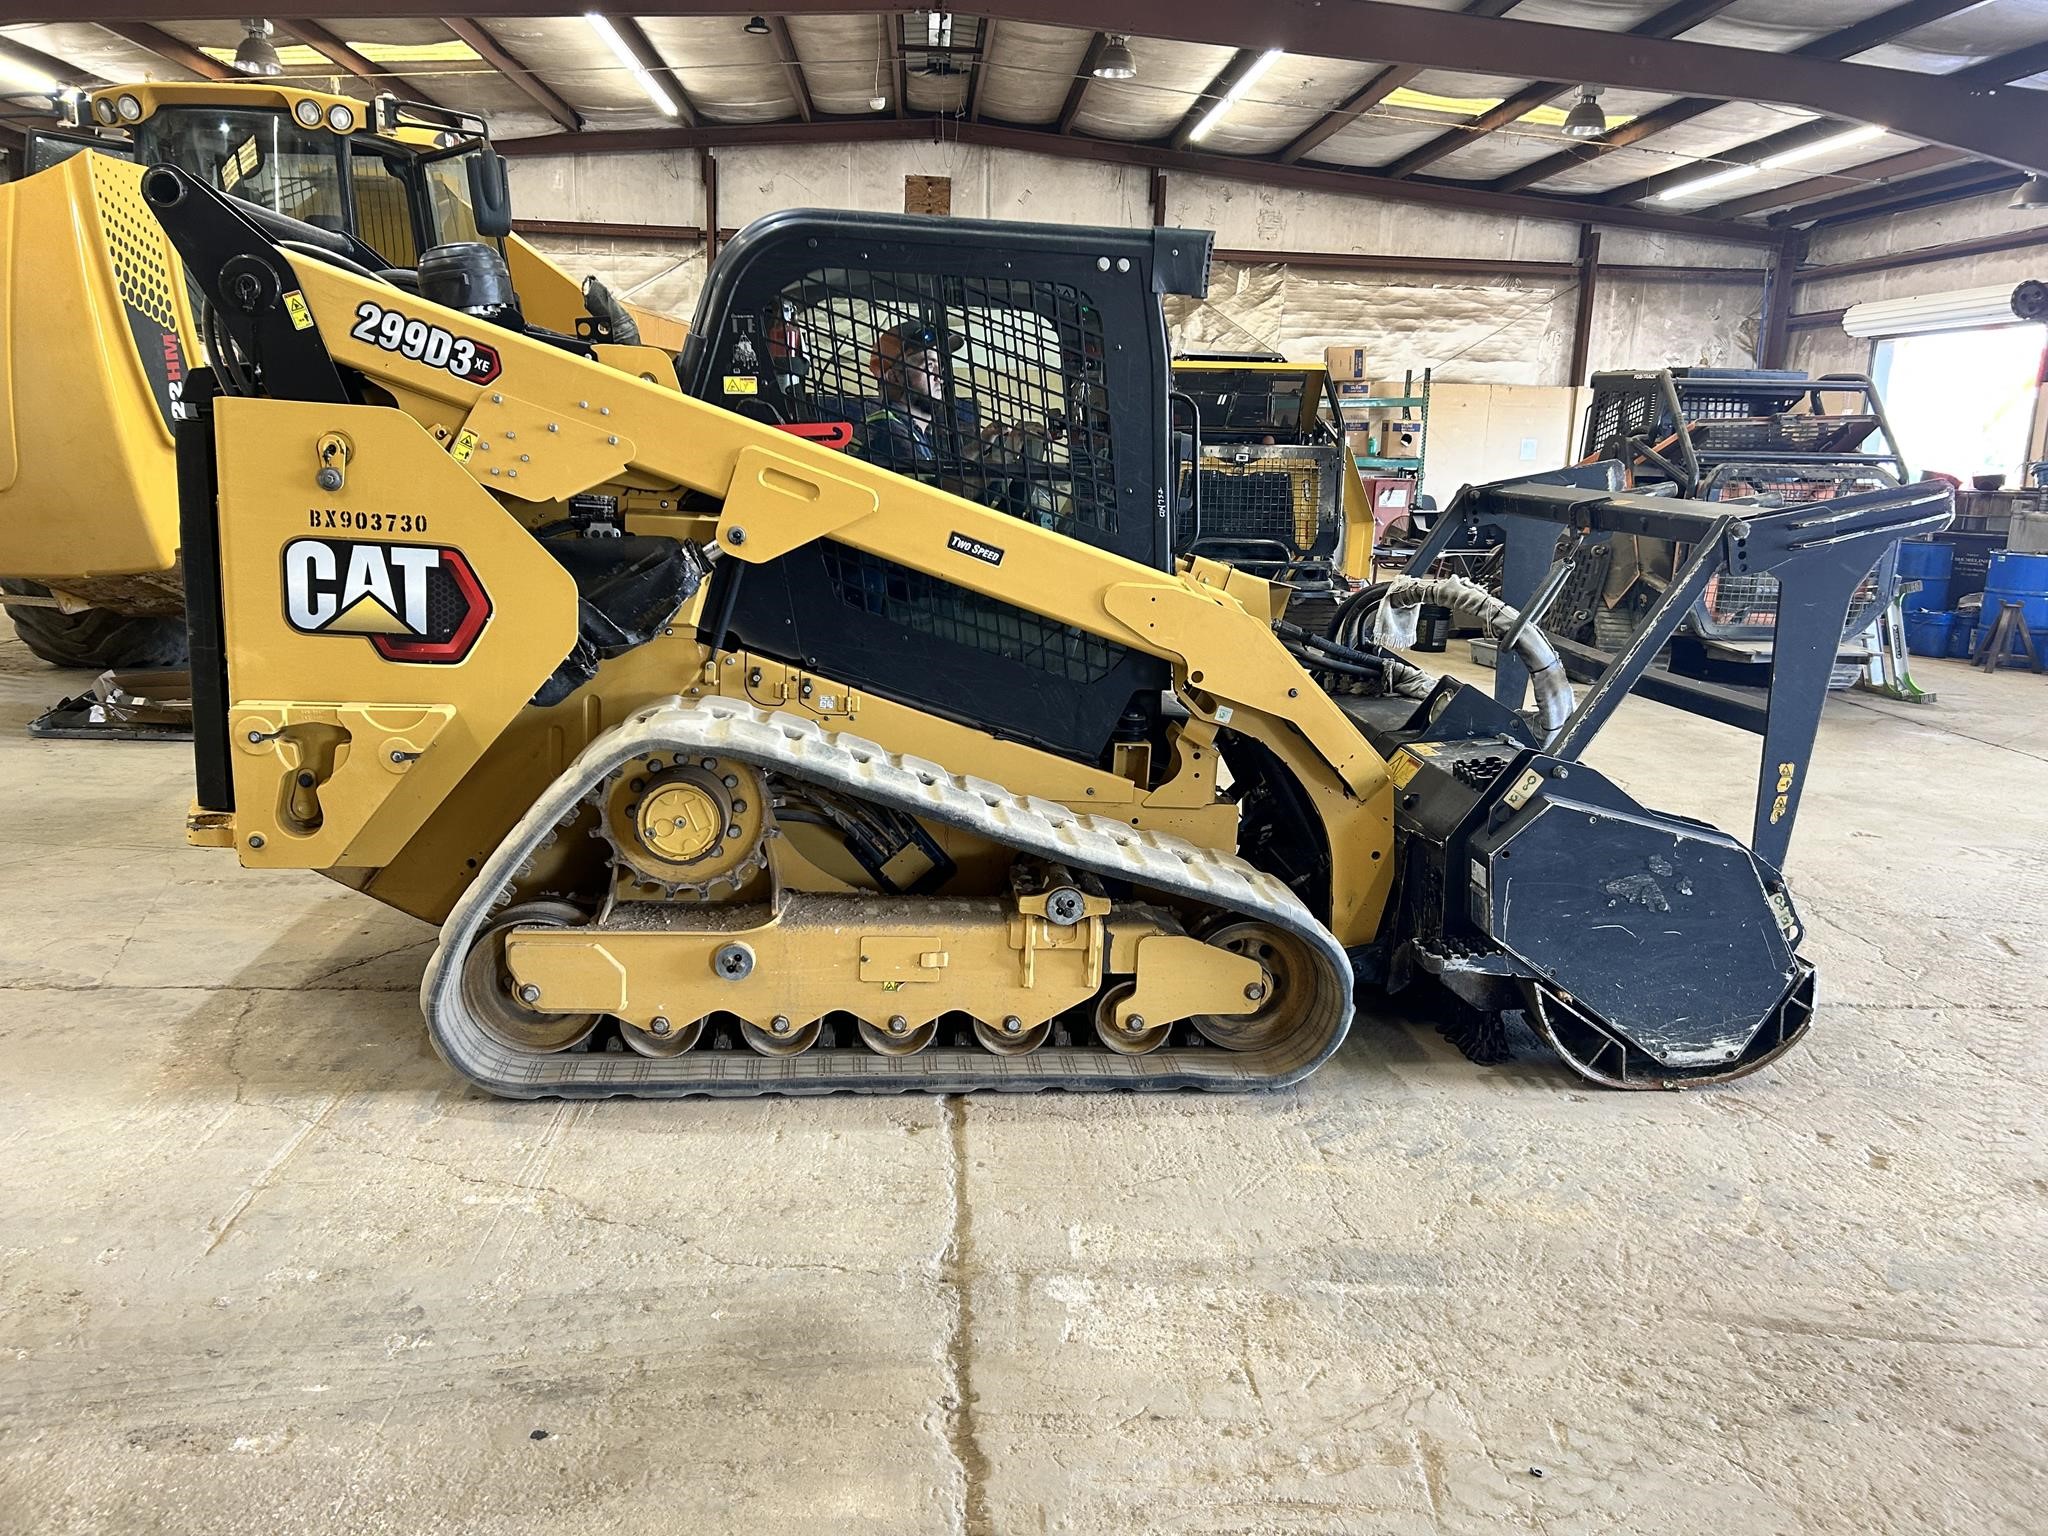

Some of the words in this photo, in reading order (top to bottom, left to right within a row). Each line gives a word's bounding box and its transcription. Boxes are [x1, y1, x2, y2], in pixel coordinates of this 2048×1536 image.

[352, 303, 476, 376] 299D3
[473, 357, 491, 373] XE
[309, 509, 428, 533] BX903730
[286, 540, 440, 635] CAT
